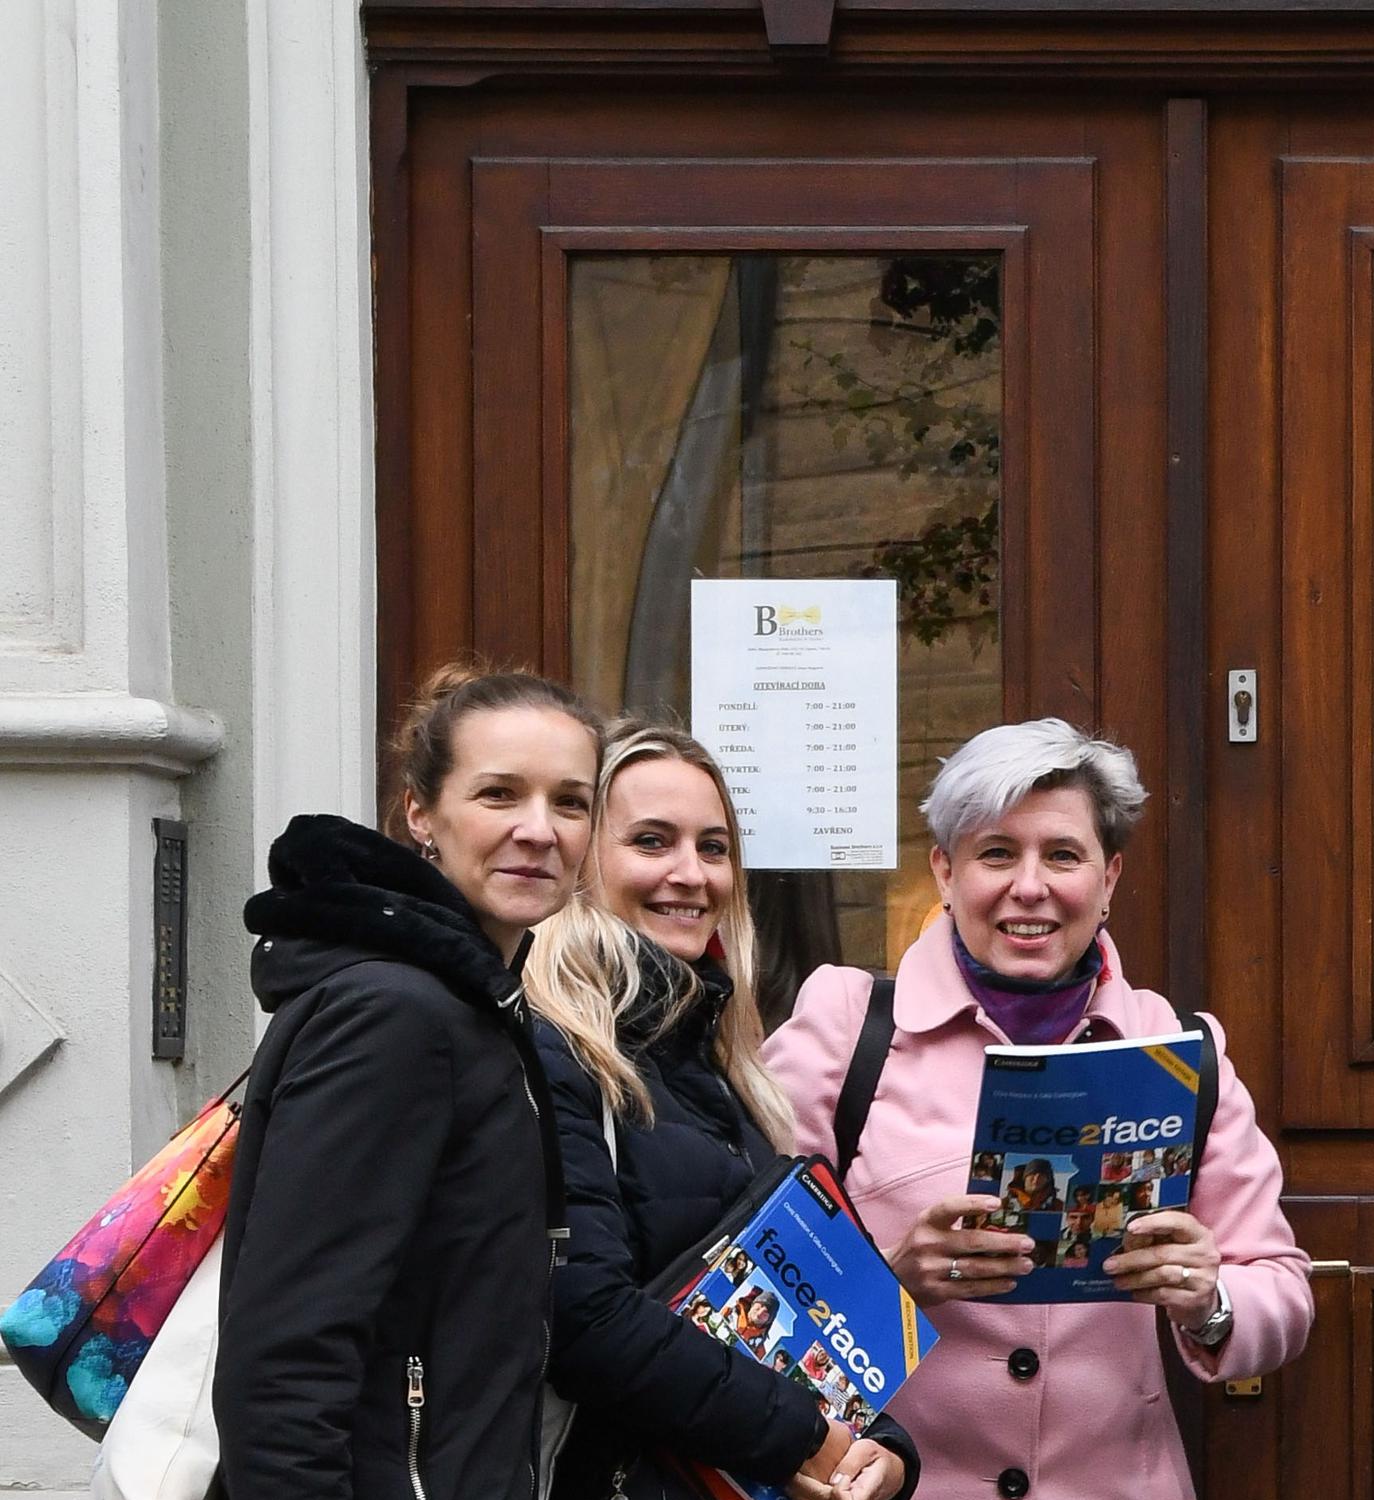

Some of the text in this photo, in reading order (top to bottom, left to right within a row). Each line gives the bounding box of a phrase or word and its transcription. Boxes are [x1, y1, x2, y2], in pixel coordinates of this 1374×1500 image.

[753, 605, 777, 636] B
[779, 626, 824, 637] Brothers
[805, 702, 824, 711] 7:00
[832, 702, 856, 711] 21:00
[805, 722, 824, 731] 7:00
[832, 722, 856, 731] 21:00
[806, 743, 825, 752] 7:00
[833, 743, 857, 752] 21:00
[806, 764, 825, 773] 7:00
[833, 764, 857, 773] 21:00
[806, 785, 825, 794] 7:00
[833, 785, 857, 794] 21:00
[813, 826, 853, 835] ZAVŘENO
[990, 1113, 1183, 1147] face2face
[754, 1227, 887, 1394] face2face
